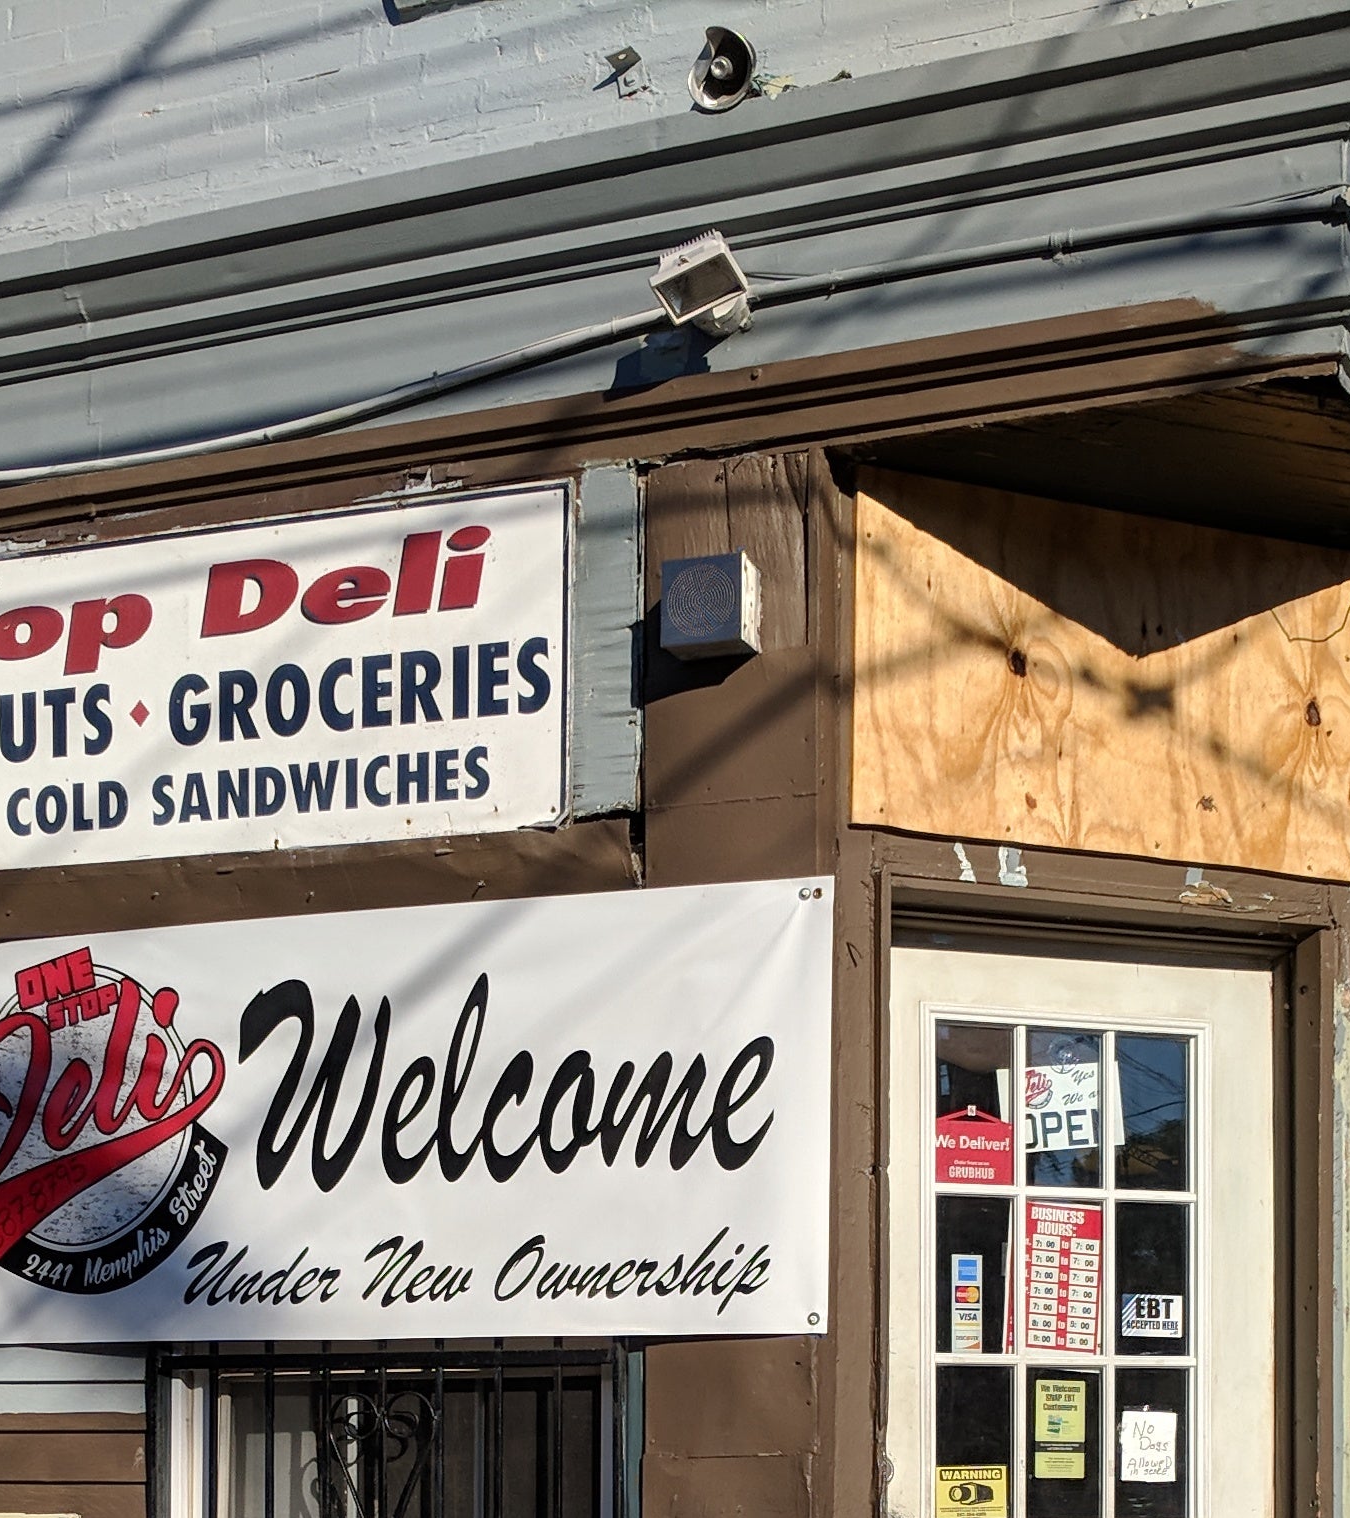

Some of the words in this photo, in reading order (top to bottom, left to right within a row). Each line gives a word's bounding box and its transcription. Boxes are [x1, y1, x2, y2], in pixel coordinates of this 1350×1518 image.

[201, 525, 491, 637] Deli
[167, 636, 551, 746] GROCERIES
[6, 780, 128, 836] COLD
[152, 746, 491, 825] SANDWICHES
[15, 947, 96, 1010] ONE
[46, 983, 119, 1032] STOP
[238, 972, 774, 1193] Welcome
[1071, 1070, 1095, 1085] Yes
[1062, 1093, 1084, 1105] We
[935, 1134, 956, 1149] We
[959, 1135, 1010, 1151] Deliver!
[948, 1166, 995, 1179] GRUBHUB
[22, 1254, 74, 1287] 2441
[83, 1228, 172, 1287] Memphis
[168, 1139, 217, 1226] Street
[1031, 1206, 1085, 1224] BUSINESS
[1037, 1221, 1077, 1237] HOURS:
[183, 1240, 341, 1307] Under
[361, 1235, 473, 1308] New
[495, 1227, 771, 1316] Ownership
[1136, 1297, 1174, 1319] EBT
[1127, 1320, 1160, 1329] ACCEPTED
[1162, 1321, 1178, 1330] HERE
[1133, 1420, 1154, 1438] No
[1139, 1436, 1168, 1452] Dogs
[941, 1470, 1001, 1480] WARNING
